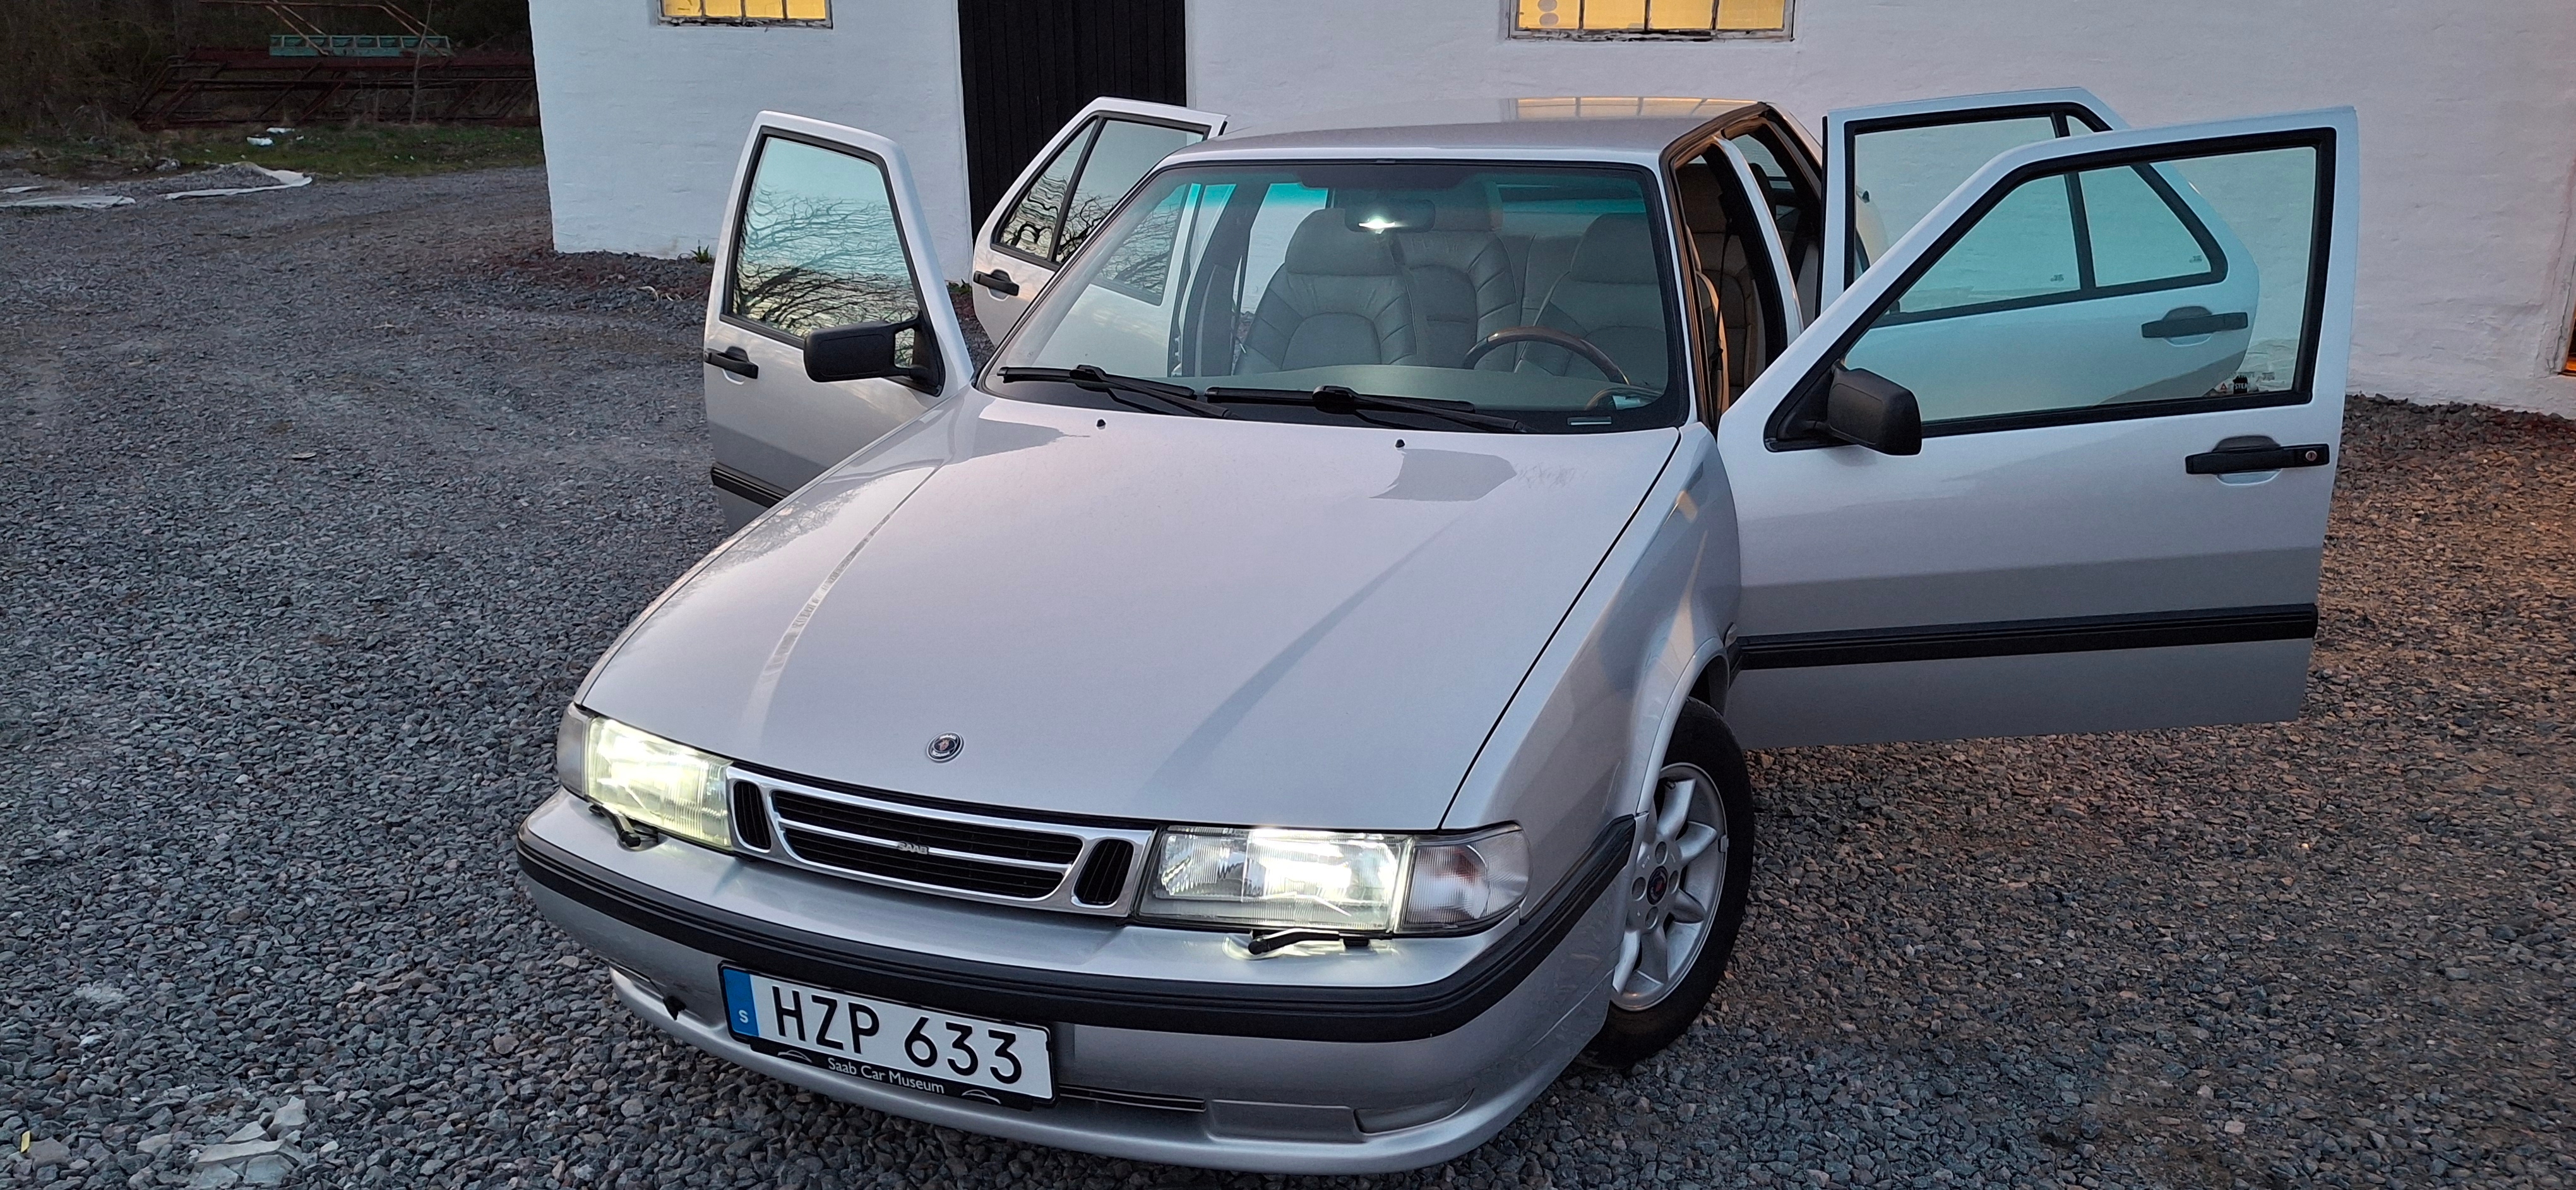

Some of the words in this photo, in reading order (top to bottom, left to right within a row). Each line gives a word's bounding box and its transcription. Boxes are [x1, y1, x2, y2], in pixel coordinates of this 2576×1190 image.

[898, 841, 929, 855] SAAB
[738, 1009, 749, 1024] S
[771, 985, 880, 1055] HZP
[904, 1016, 1022, 1085] 633
[827, 1057, 857, 1075] Saab
[861, 1065, 886, 1081] Car
[888, 1070, 945, 1094] Museum
